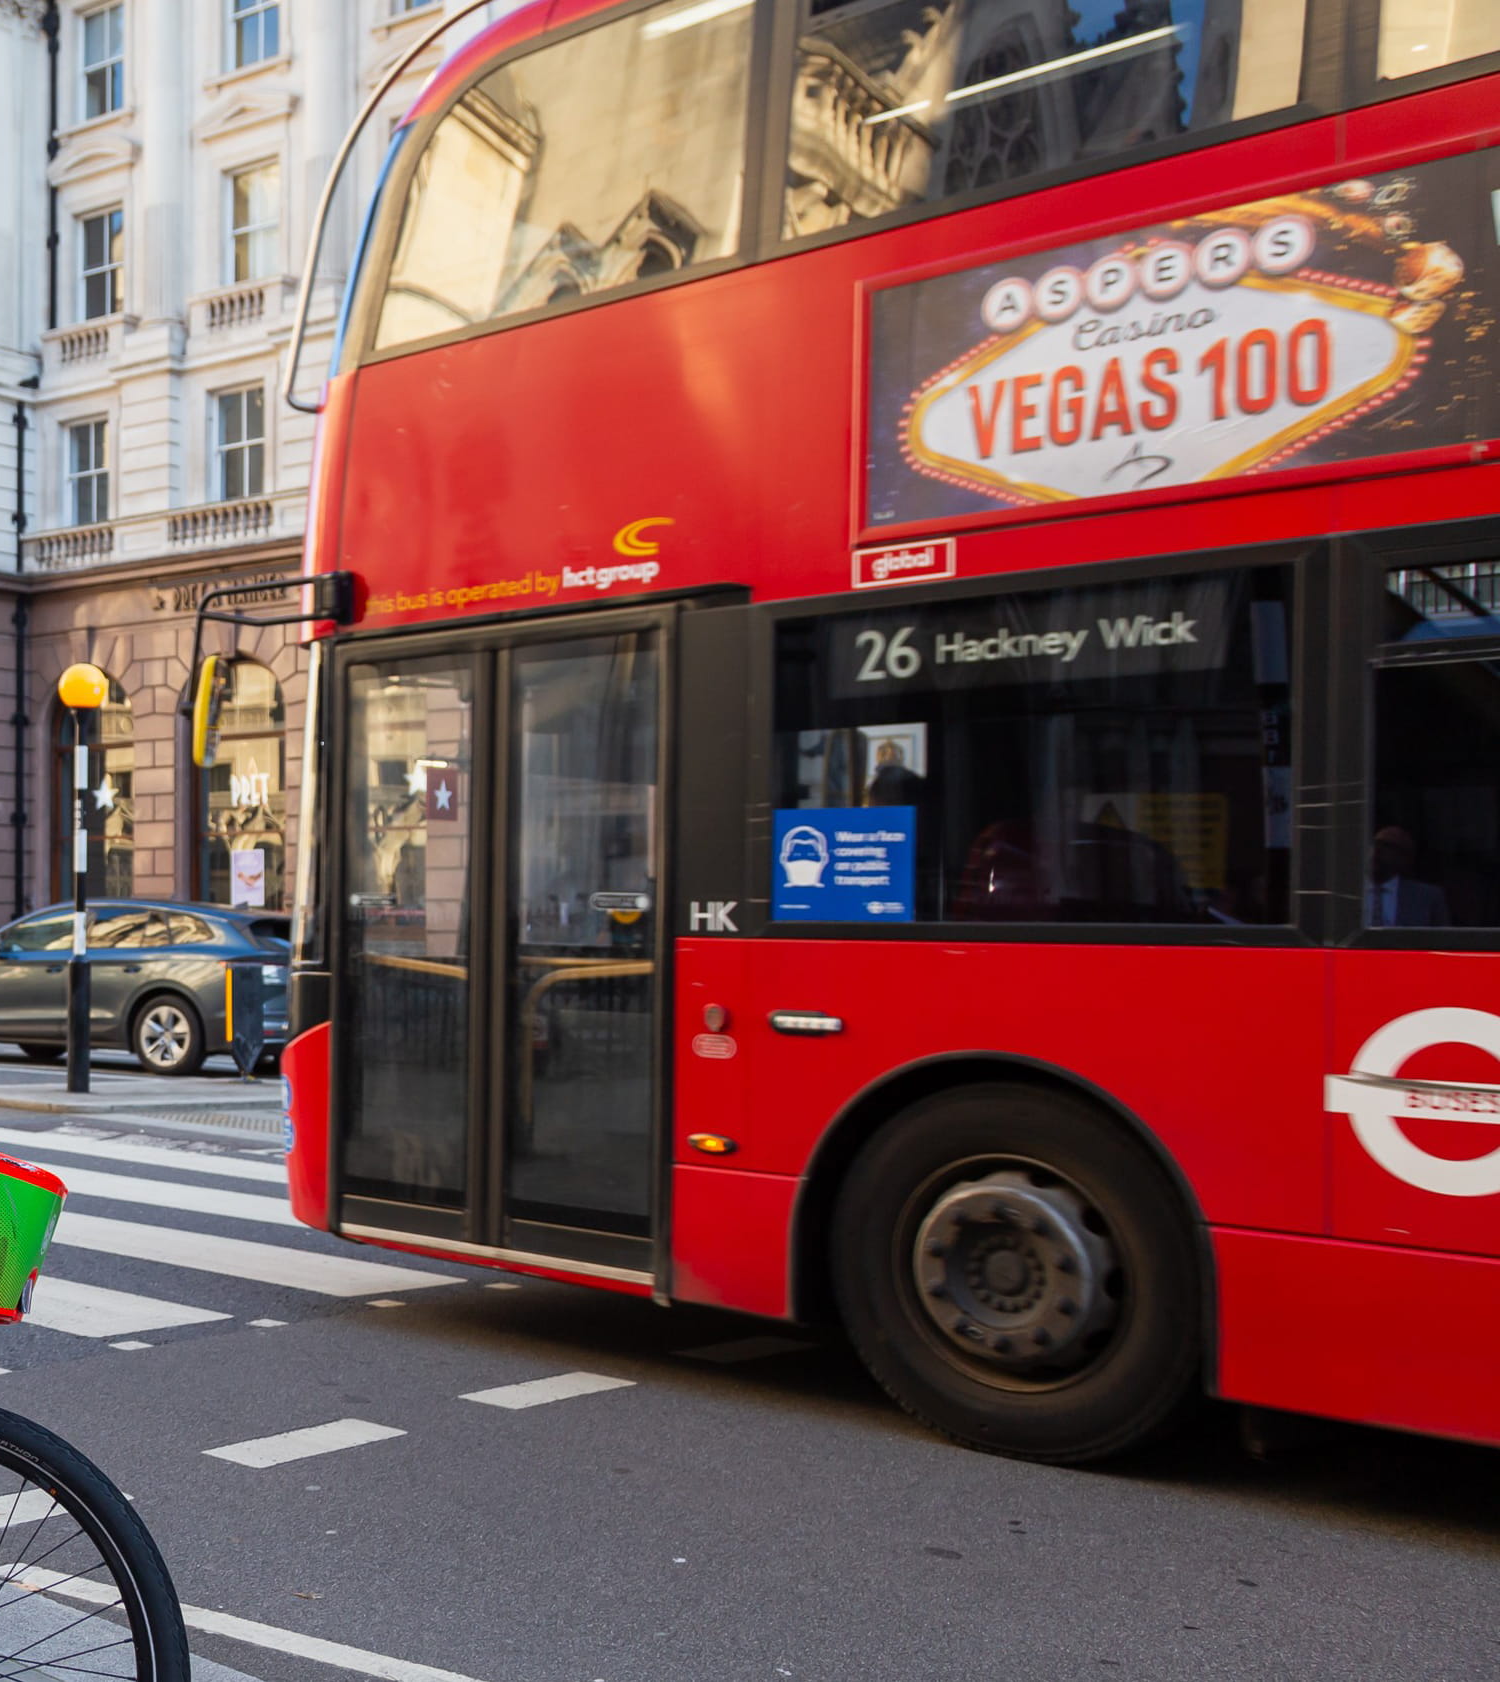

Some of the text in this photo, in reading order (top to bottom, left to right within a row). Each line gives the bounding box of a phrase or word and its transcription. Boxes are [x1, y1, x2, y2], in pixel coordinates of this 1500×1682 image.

[993, 229, 1295, 318] ASPERS
[1073, 307, 1218, 352] Casino
[967, 318, 1332, 461] VEGAS 100
[871, 546, 935, 580] global
[397, 590, 428, 612] bus
[431, 587, 443, 607] is
[446, 572, 533, 609] operated
[535, 570, 560, 596] by
[855, 611, 1199, 682] 26 Hackney Wick
[230, 772, 270, 808] PRET
[690, 900, 739, 932] HK
